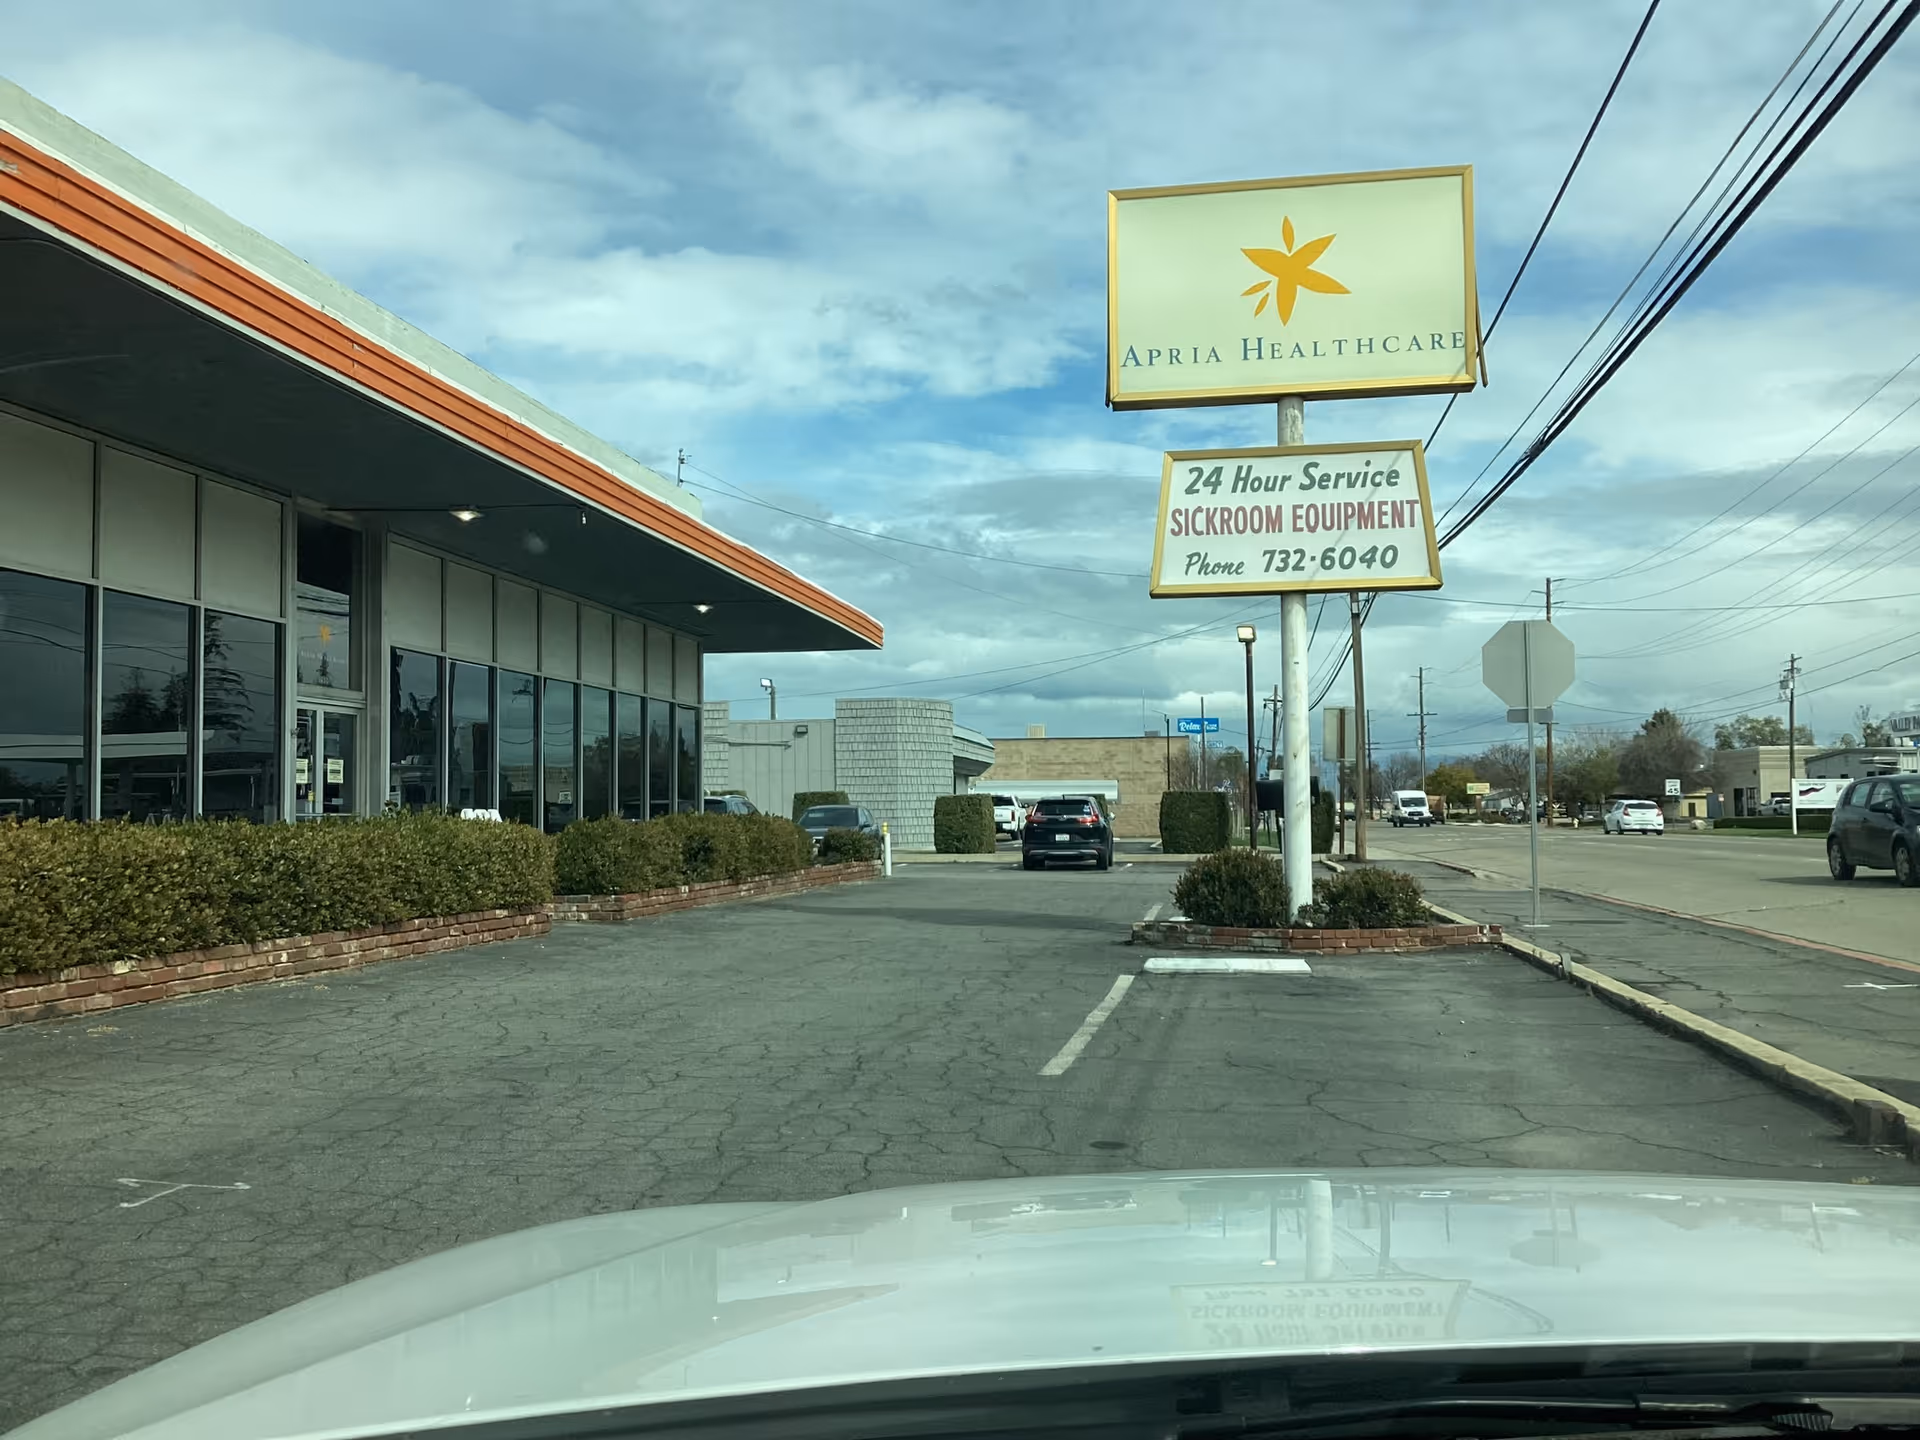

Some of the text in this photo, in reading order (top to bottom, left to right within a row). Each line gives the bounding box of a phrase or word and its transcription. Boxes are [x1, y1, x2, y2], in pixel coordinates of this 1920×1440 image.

[1120, 331, 1466, 368] APRIA HEALTHCARE
[1184, 459, 1401, 495] 24 Hour Service
[1170, 499, 1420, 537] SICKROOM EQUIPMENT
[1184, 551, 1246, 577] Phone
